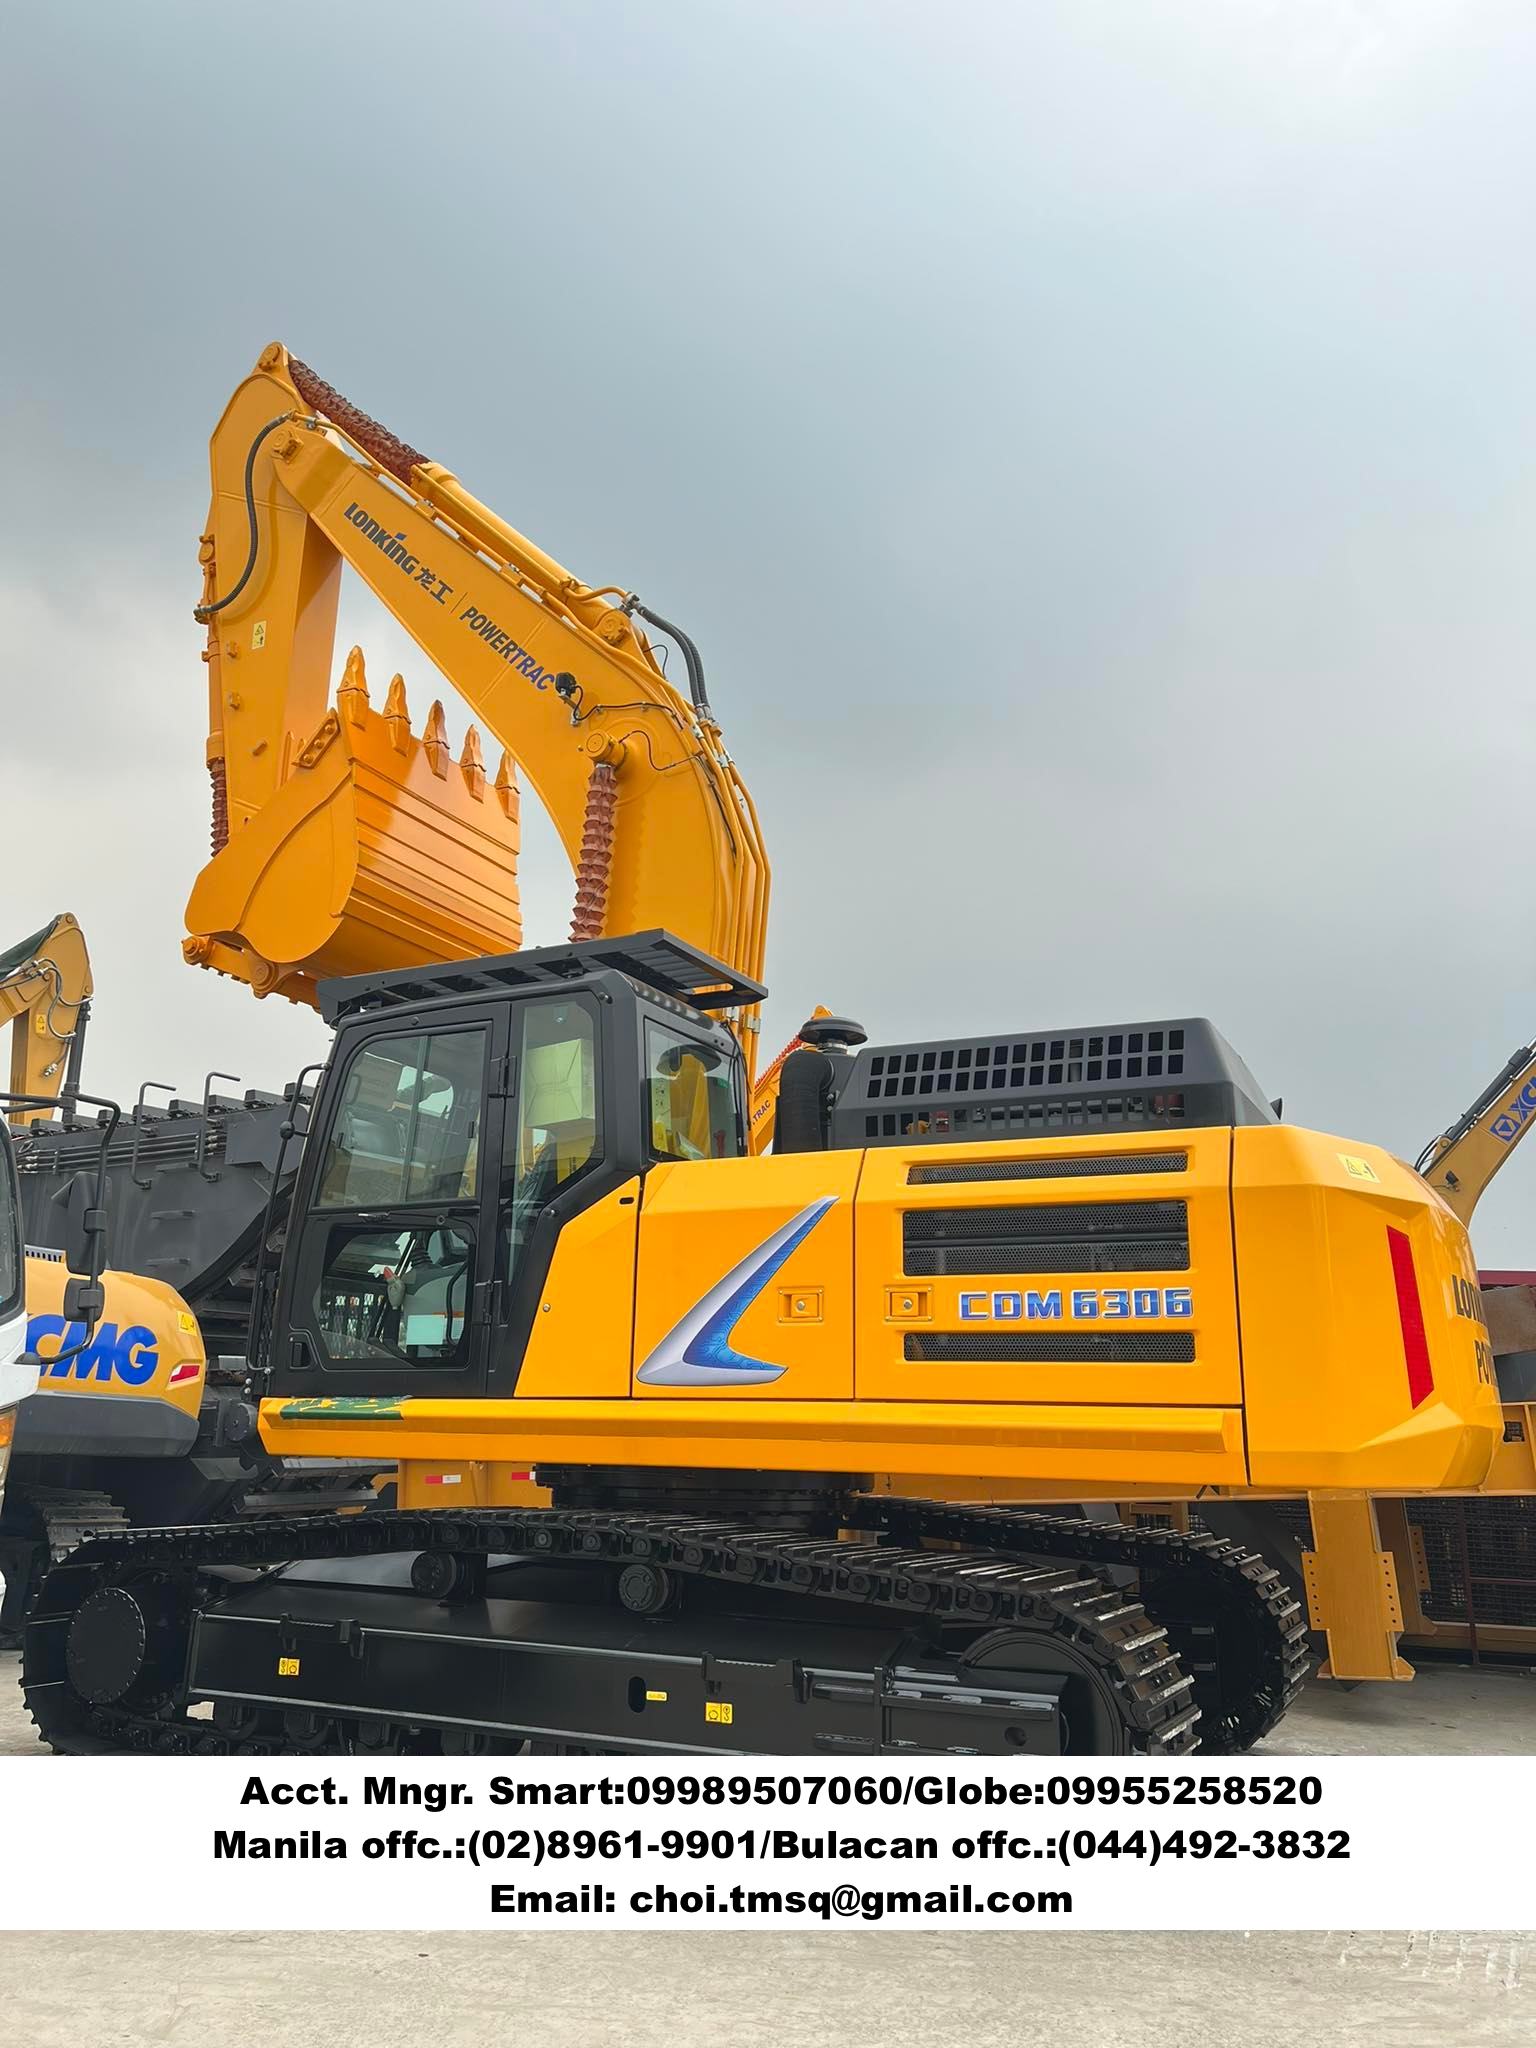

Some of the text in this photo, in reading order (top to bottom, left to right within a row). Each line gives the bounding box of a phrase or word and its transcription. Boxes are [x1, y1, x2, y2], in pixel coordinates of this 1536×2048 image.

[414, 566, 454, 605] 龙工
[459, 606, 554, 690] POWERTRAC
[752, 1100, 771, 1126] TRAC
[1508, 1076, 1536, 1124] XC
[958, 1287, 1194, 1321] CDM 6306
[26, 1313, 160, 1386] CMG
